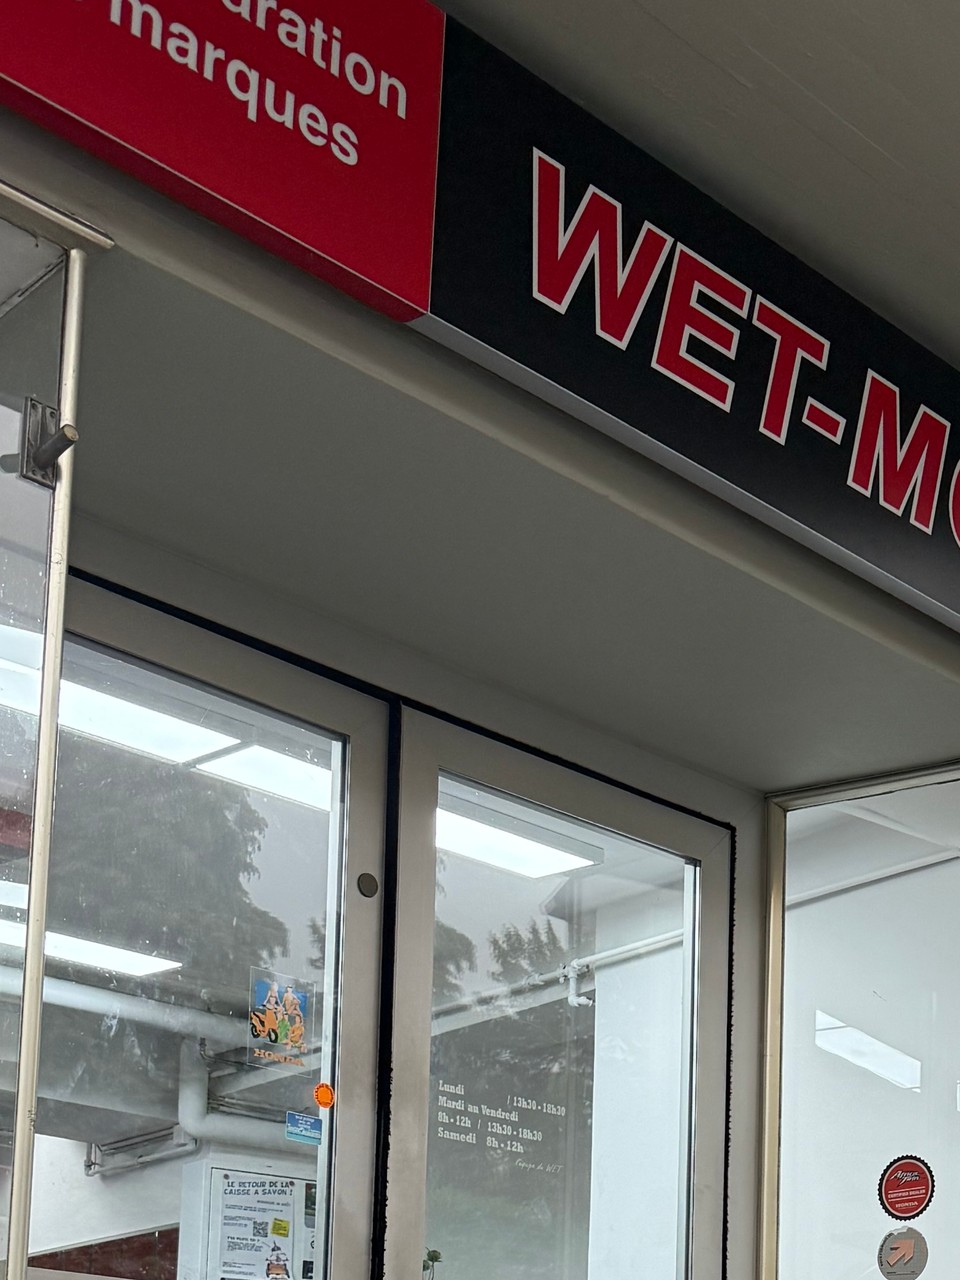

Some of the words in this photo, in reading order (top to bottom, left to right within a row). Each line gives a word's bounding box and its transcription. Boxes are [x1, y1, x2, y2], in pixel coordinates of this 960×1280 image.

[110, 0, 359, 166] marques
[253, 1048, 305, 1067] HONDA
[439, 1080, 465, 1095] Lundi
[438, 1095, 465, 1111] Mardi
[481, 1105, 519, 1122] Vendredi
[437, 1127, 476, 1144] Samedi
[261, 1188, 288, 1196] SAVON
